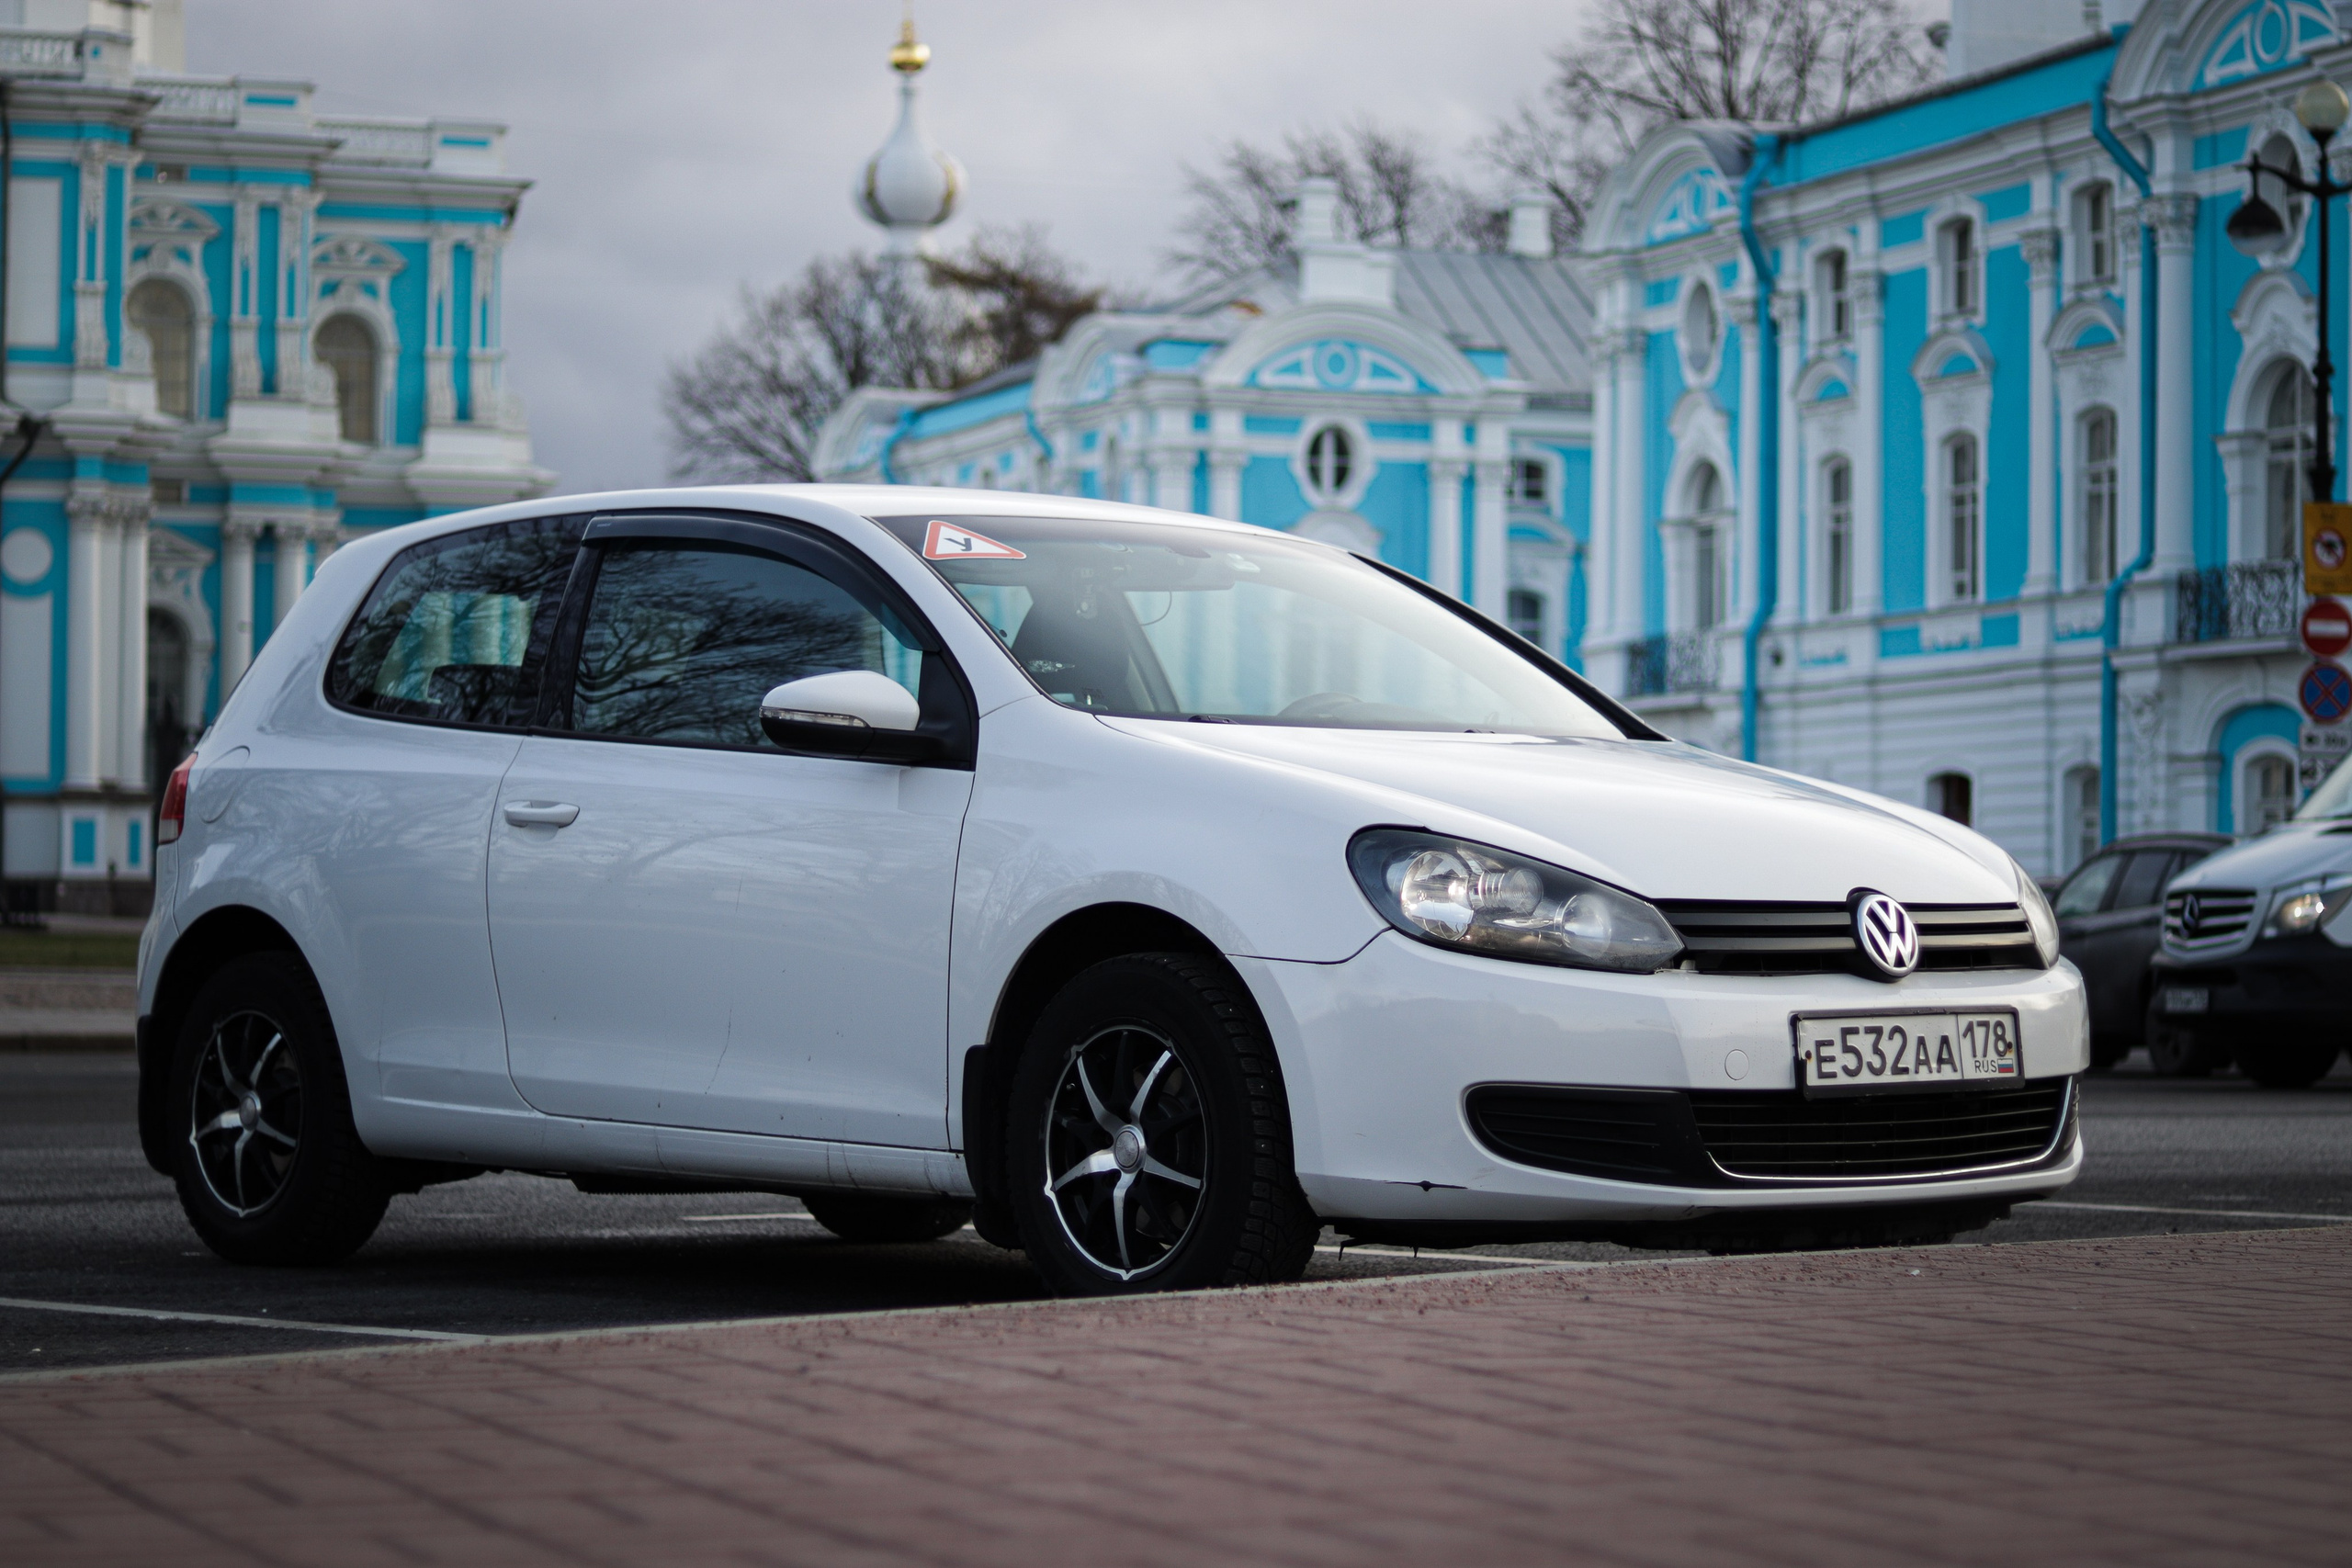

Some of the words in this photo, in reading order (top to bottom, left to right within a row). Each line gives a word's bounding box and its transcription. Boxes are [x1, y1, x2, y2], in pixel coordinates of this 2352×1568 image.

[1860, 898, 1915, 972] VW
[1815, 1025, 1958, 1079] E532AA
[1962, 1020, 2007, 1058] 178
[1974, 1059, 1997, 1074] RUS
